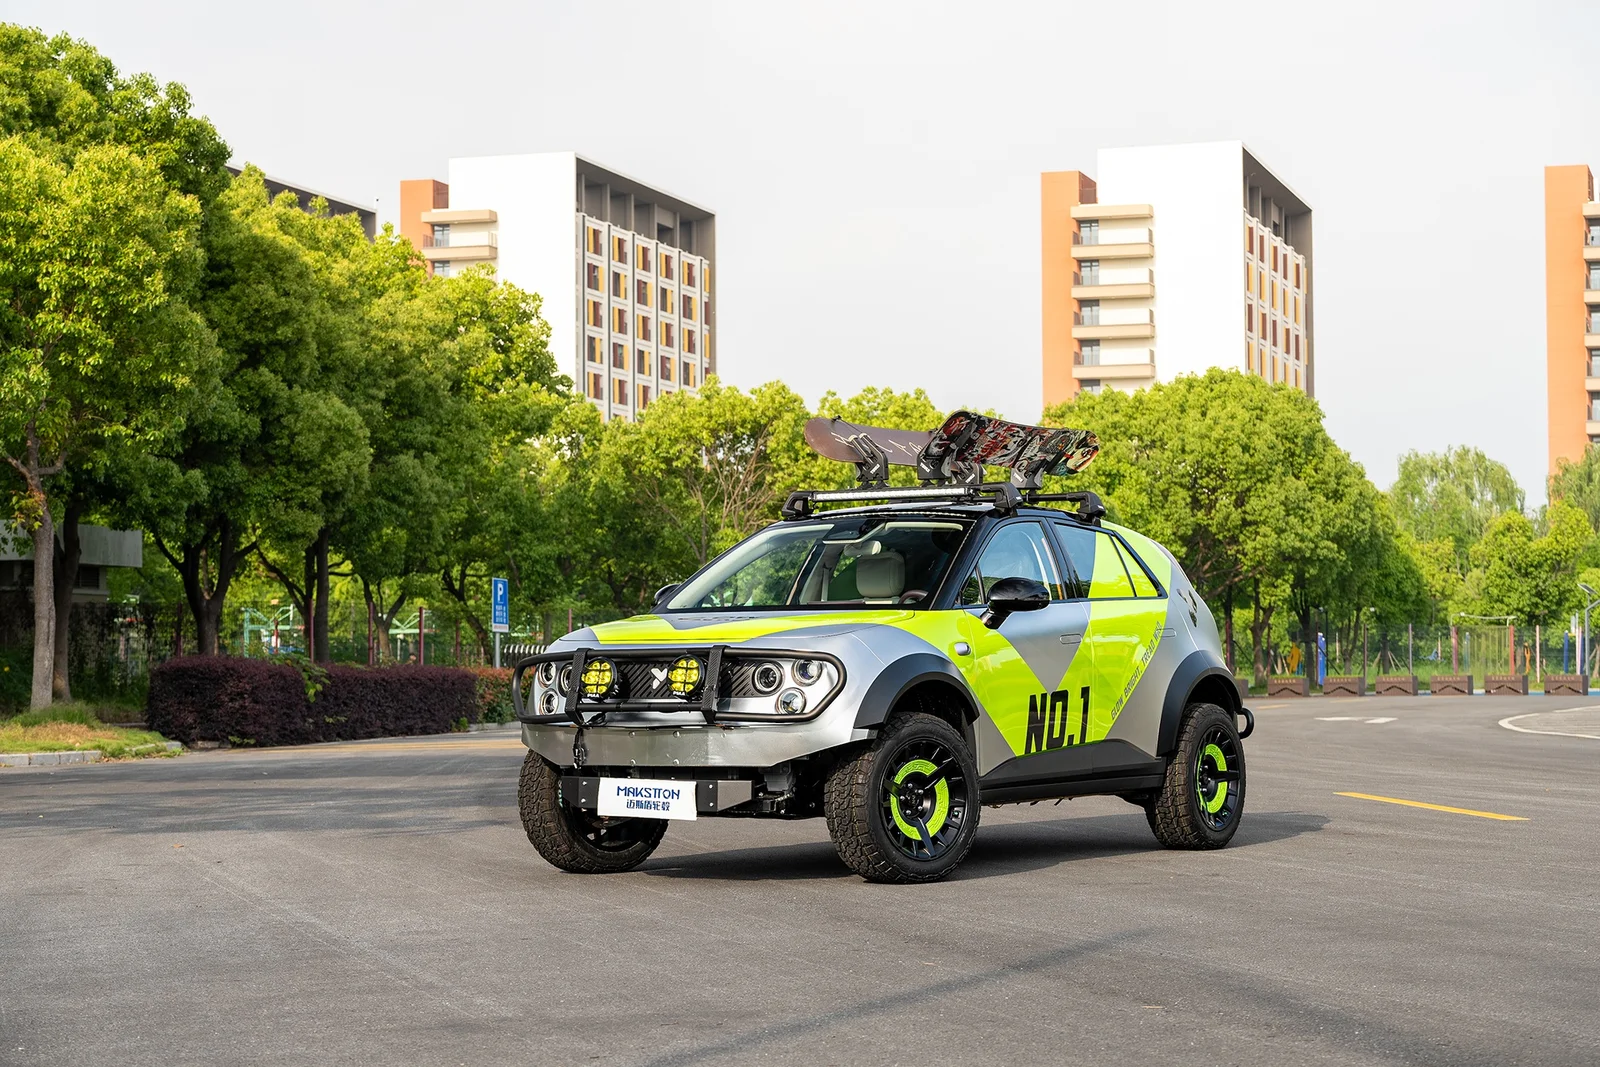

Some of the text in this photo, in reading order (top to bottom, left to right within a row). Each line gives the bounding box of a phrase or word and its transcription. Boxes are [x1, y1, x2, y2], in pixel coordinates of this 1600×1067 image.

[497, 583, 504, 602] P
[1111, 694, 1124, 720] GLOW
[1141, 639, 1156, 667] TREAD
[1025, 686, 1091, 754] NO.1
